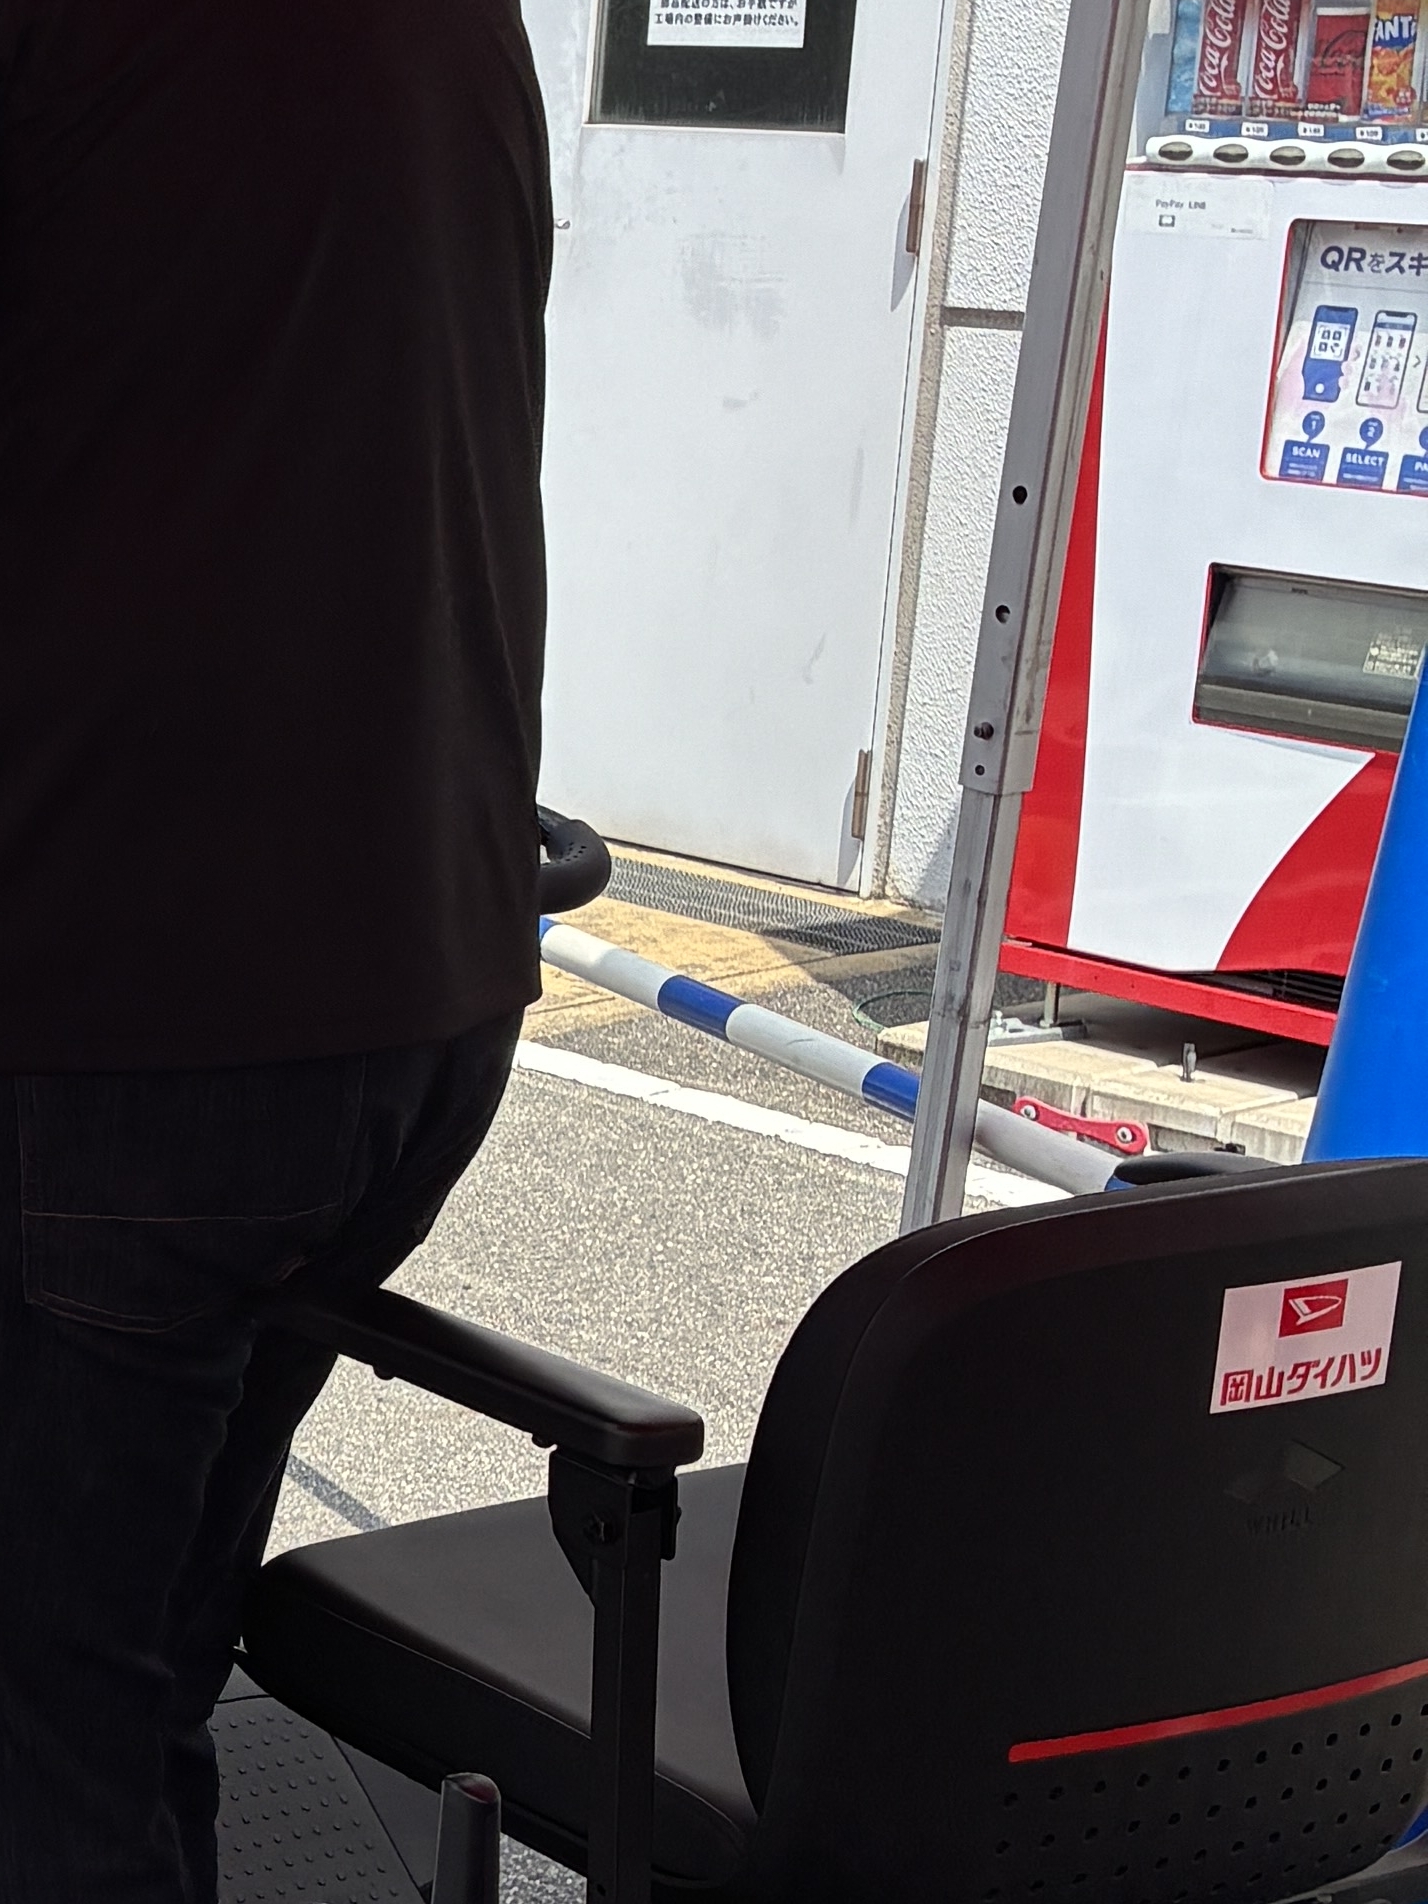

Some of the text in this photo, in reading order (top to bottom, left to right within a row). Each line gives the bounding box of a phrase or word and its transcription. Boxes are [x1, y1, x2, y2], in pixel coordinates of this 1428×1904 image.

[1291, 446, 1322, 460] SCAN
[1345, 452, 1384, 467] SELECT
[1219, 1346, 1383, 1407] 岡山ダイハツ
